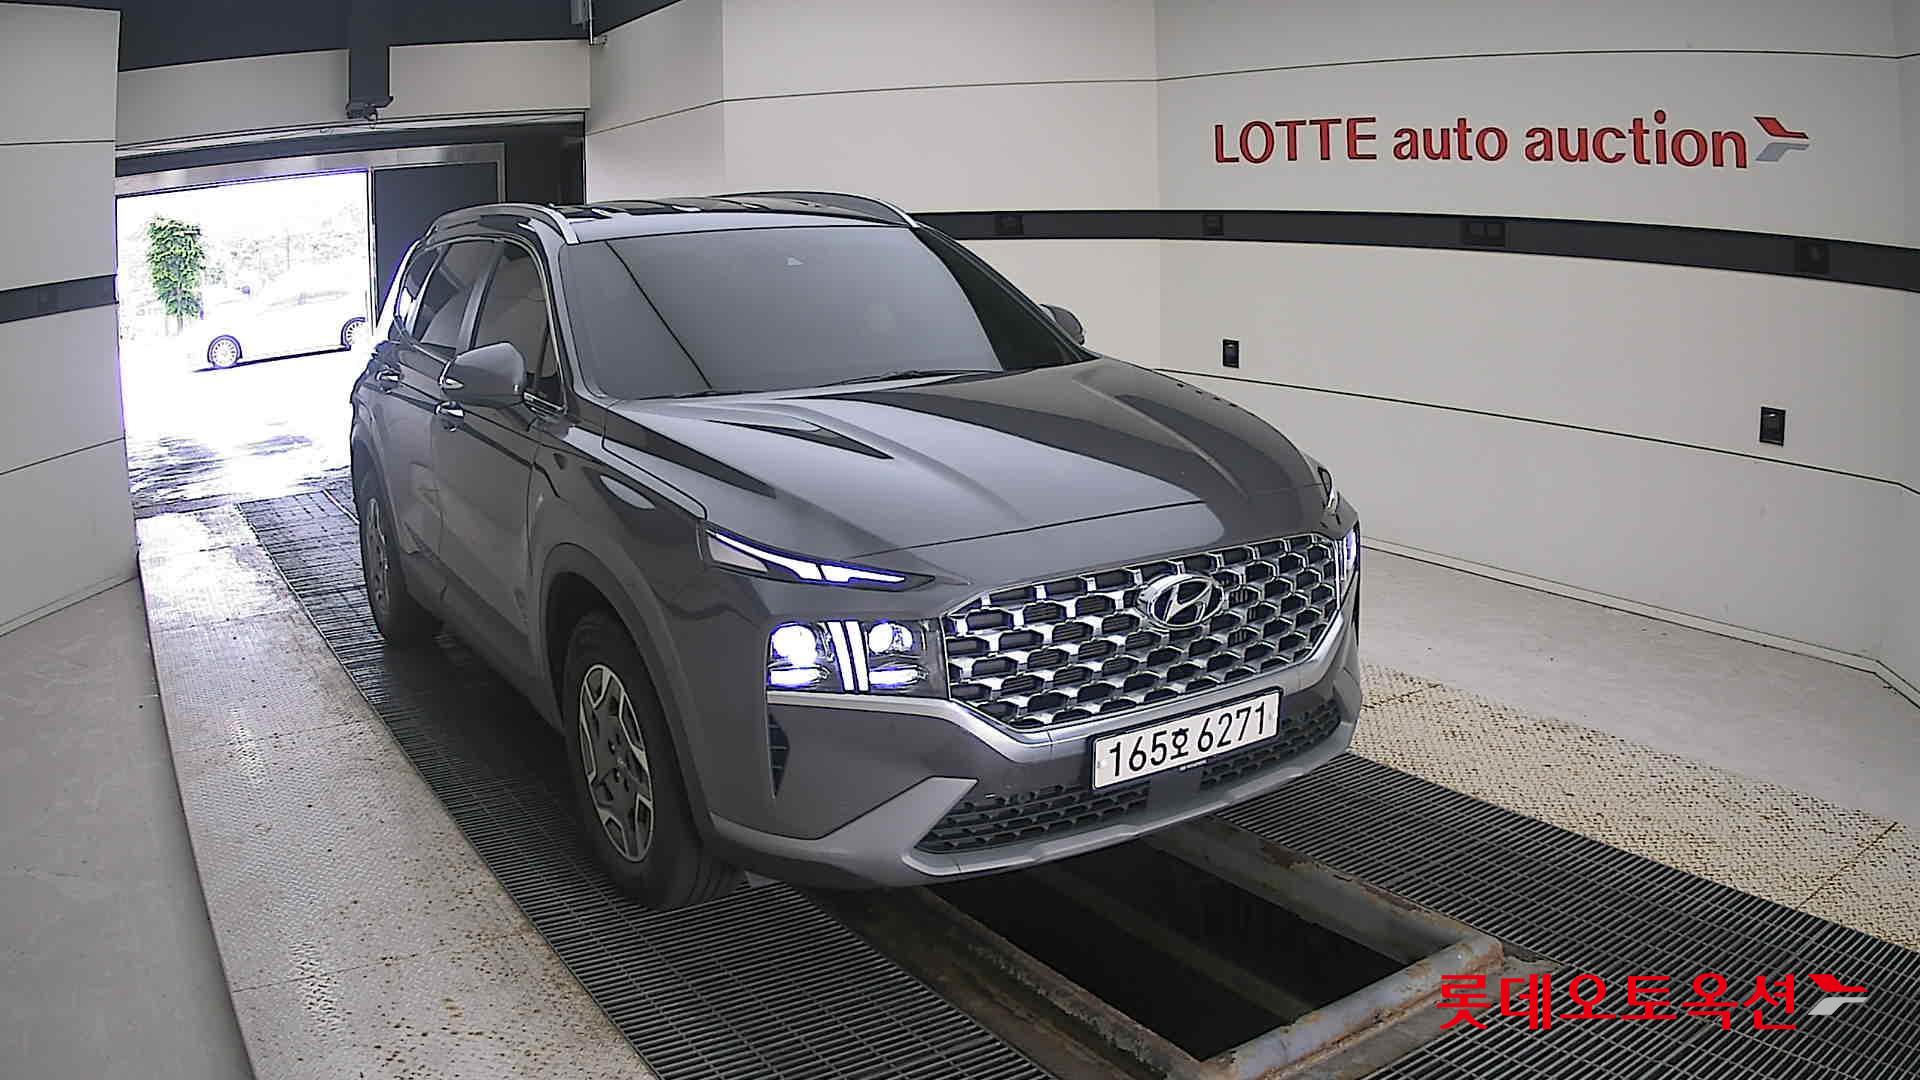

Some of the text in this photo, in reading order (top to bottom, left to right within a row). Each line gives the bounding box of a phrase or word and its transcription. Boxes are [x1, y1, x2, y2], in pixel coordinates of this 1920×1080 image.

[1214, 109, 1749, 169] LOTTE auto auction
[1109, 701, 1266, 777] 165호 6271
